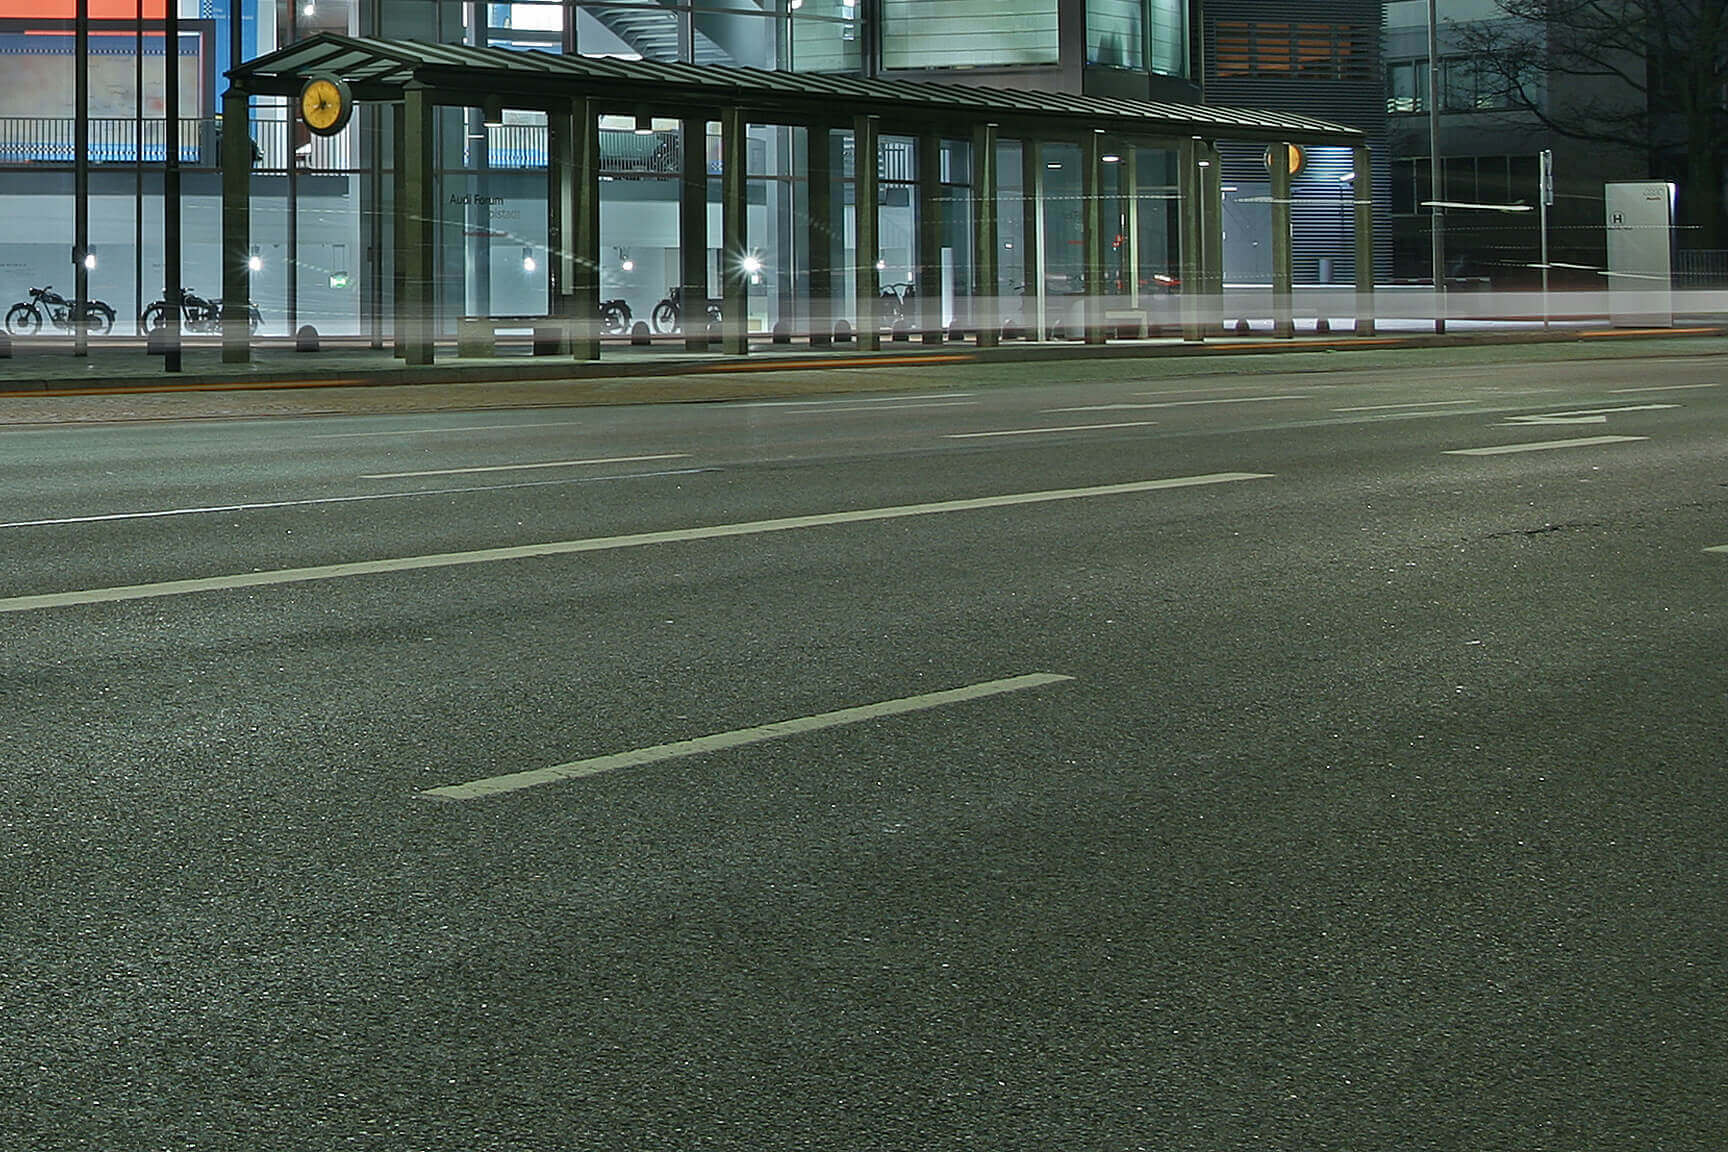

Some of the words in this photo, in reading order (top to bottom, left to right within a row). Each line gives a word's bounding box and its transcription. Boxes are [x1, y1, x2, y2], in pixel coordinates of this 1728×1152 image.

[449, 193, 473, 205] Audi
[474, 193, 504, 206] Forum
[1613, 214, 1622, 224] H
